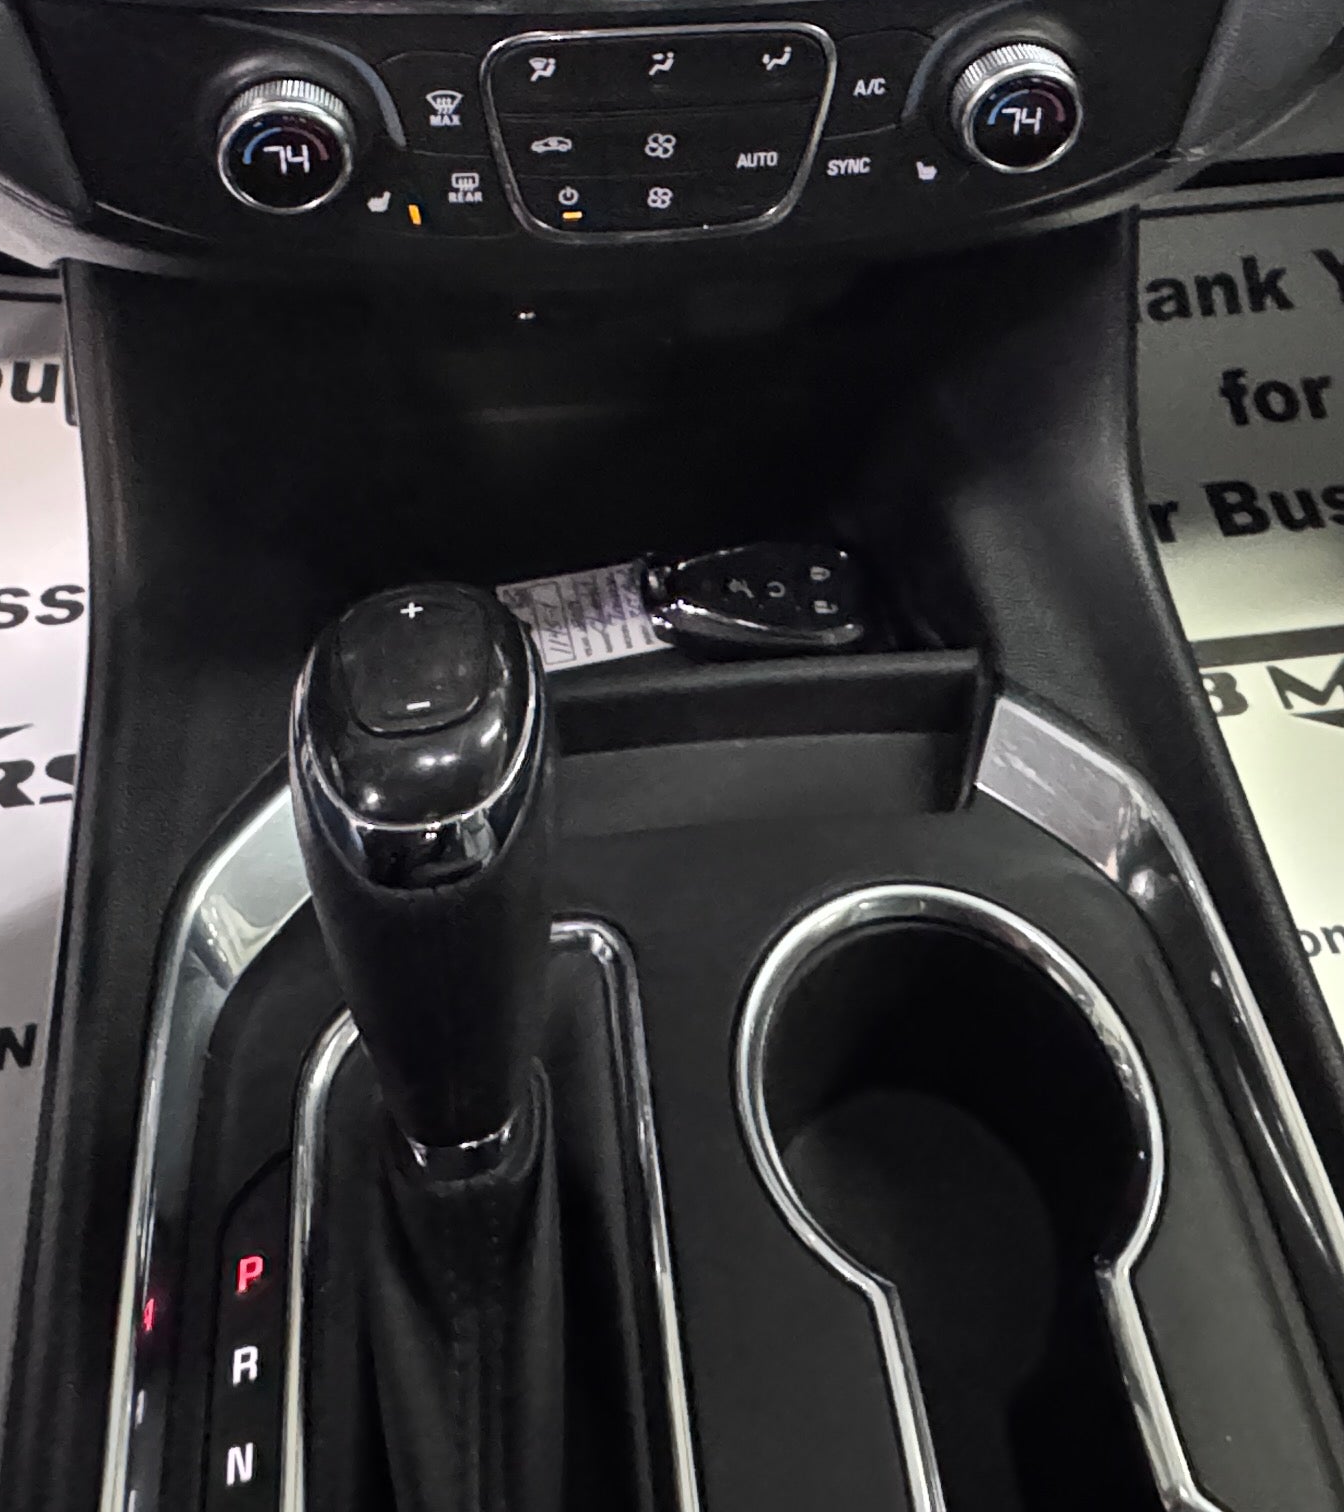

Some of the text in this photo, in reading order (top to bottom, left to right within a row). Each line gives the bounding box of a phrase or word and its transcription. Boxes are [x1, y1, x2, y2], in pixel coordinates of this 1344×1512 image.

[853, 77, 886, 97] A/C
[429, 113, 461, 127] MAX
[1000, 106, 1043, 136] 74
[261, 143, 311, 175] 74
[736, 151, 779, 169] AUTO
[826, 156, 871, 176] SYNC
[448, 190, 483, 204] REAR
[1144, 255, 1295, 323] ank
[1219, 367, 1332, 427] for
[237, 1255, 264, 1294] P
[232, 1345, 259, 1385] R
[226, 1442, 254, 1486] N
